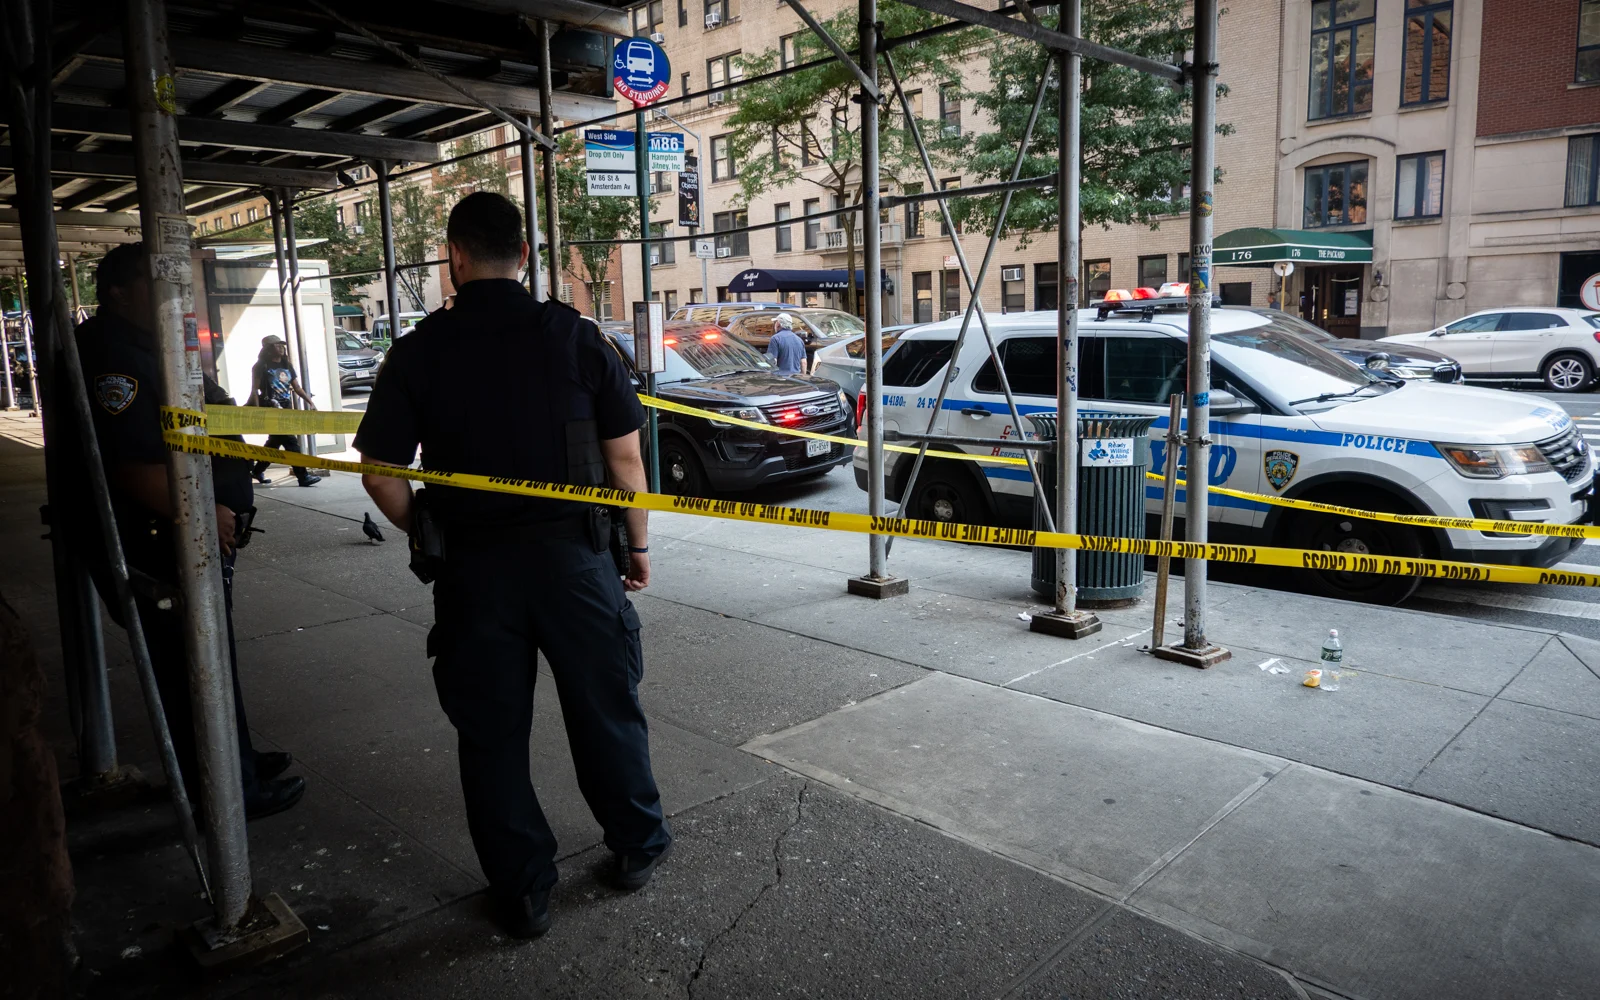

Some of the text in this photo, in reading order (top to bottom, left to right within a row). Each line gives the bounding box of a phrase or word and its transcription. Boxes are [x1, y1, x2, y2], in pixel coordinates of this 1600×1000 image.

[616, 80, 628, 92] NO
[628, 84, 664, 100] STANDING
[588, 132, 602, 140] West
[651, 137, 679, 151] M86
[588, 151, 601, 159] Drop
[612, 152, 625, 160] Only
[651, 153, 678, 162] Hampton
[651, 162, 681, 171] Jitney, Inc
[1231, 251, 1253, 261] 176
[1291, 249, 1346, 259] 176 THE PACKARD
[98, 380, 135, 389] DEPARTMENT
[888, 396, 904, 407] 4180
[917, 398, 926, 408] 24
[1343, 433, 1406, 453] POLICE
[1266, 455, 1297, 465] DEPARTMENT
[1273, 451, 1292, 459] POLICE
[713, 500, 735, 514] NOT
[740, 502, 755, 517] DO
[759, 504, 785, 521] LINE
[788, 508, 830, 526] POLICE
[870, 515, 1037, 546] POLICE LINE DO NOT CROSS
[1079, 535, 1257, 563] POLICE LINE DO NOT CROSS
[1302, 552, 1491, 581] POLICE LINE DO NOT CROSS
